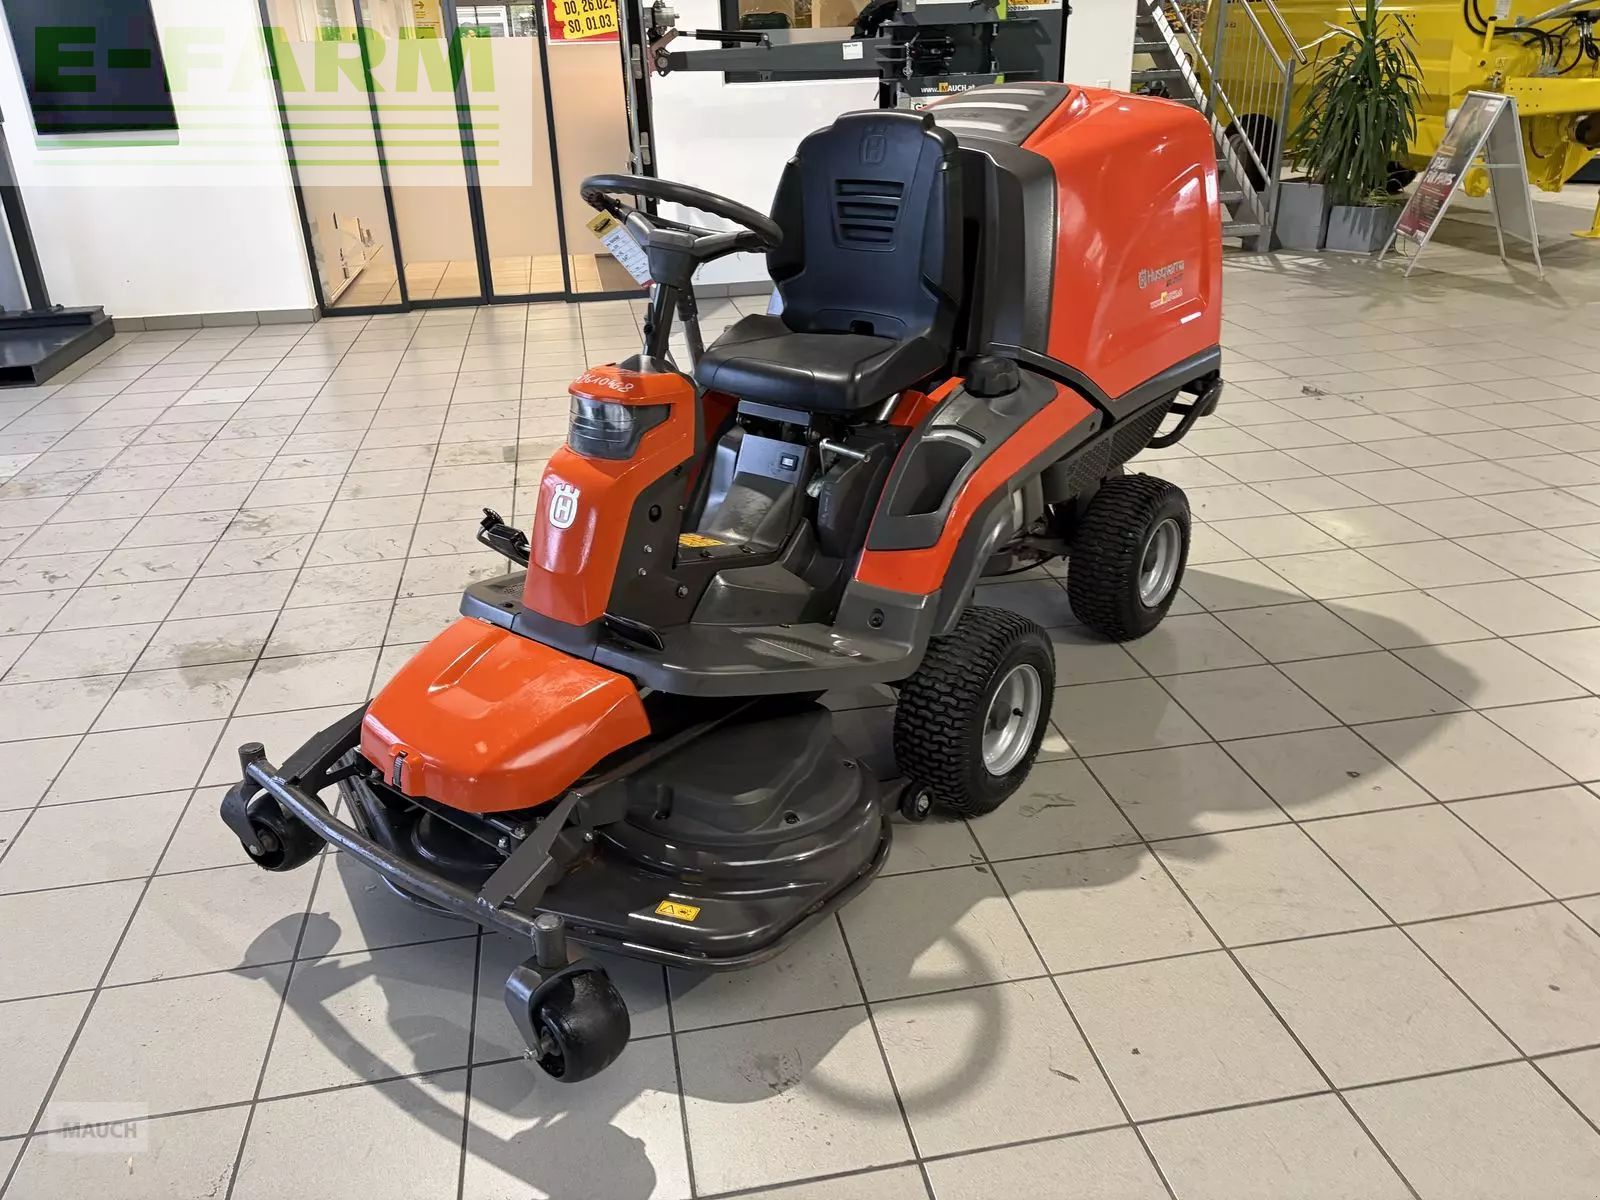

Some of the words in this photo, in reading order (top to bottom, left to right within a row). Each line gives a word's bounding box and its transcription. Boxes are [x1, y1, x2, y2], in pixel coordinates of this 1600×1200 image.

[564, 1, 580, 16] DO,
[568, 19, 584, 34] SO,
[586, 14, 615, 31] 01.03.
